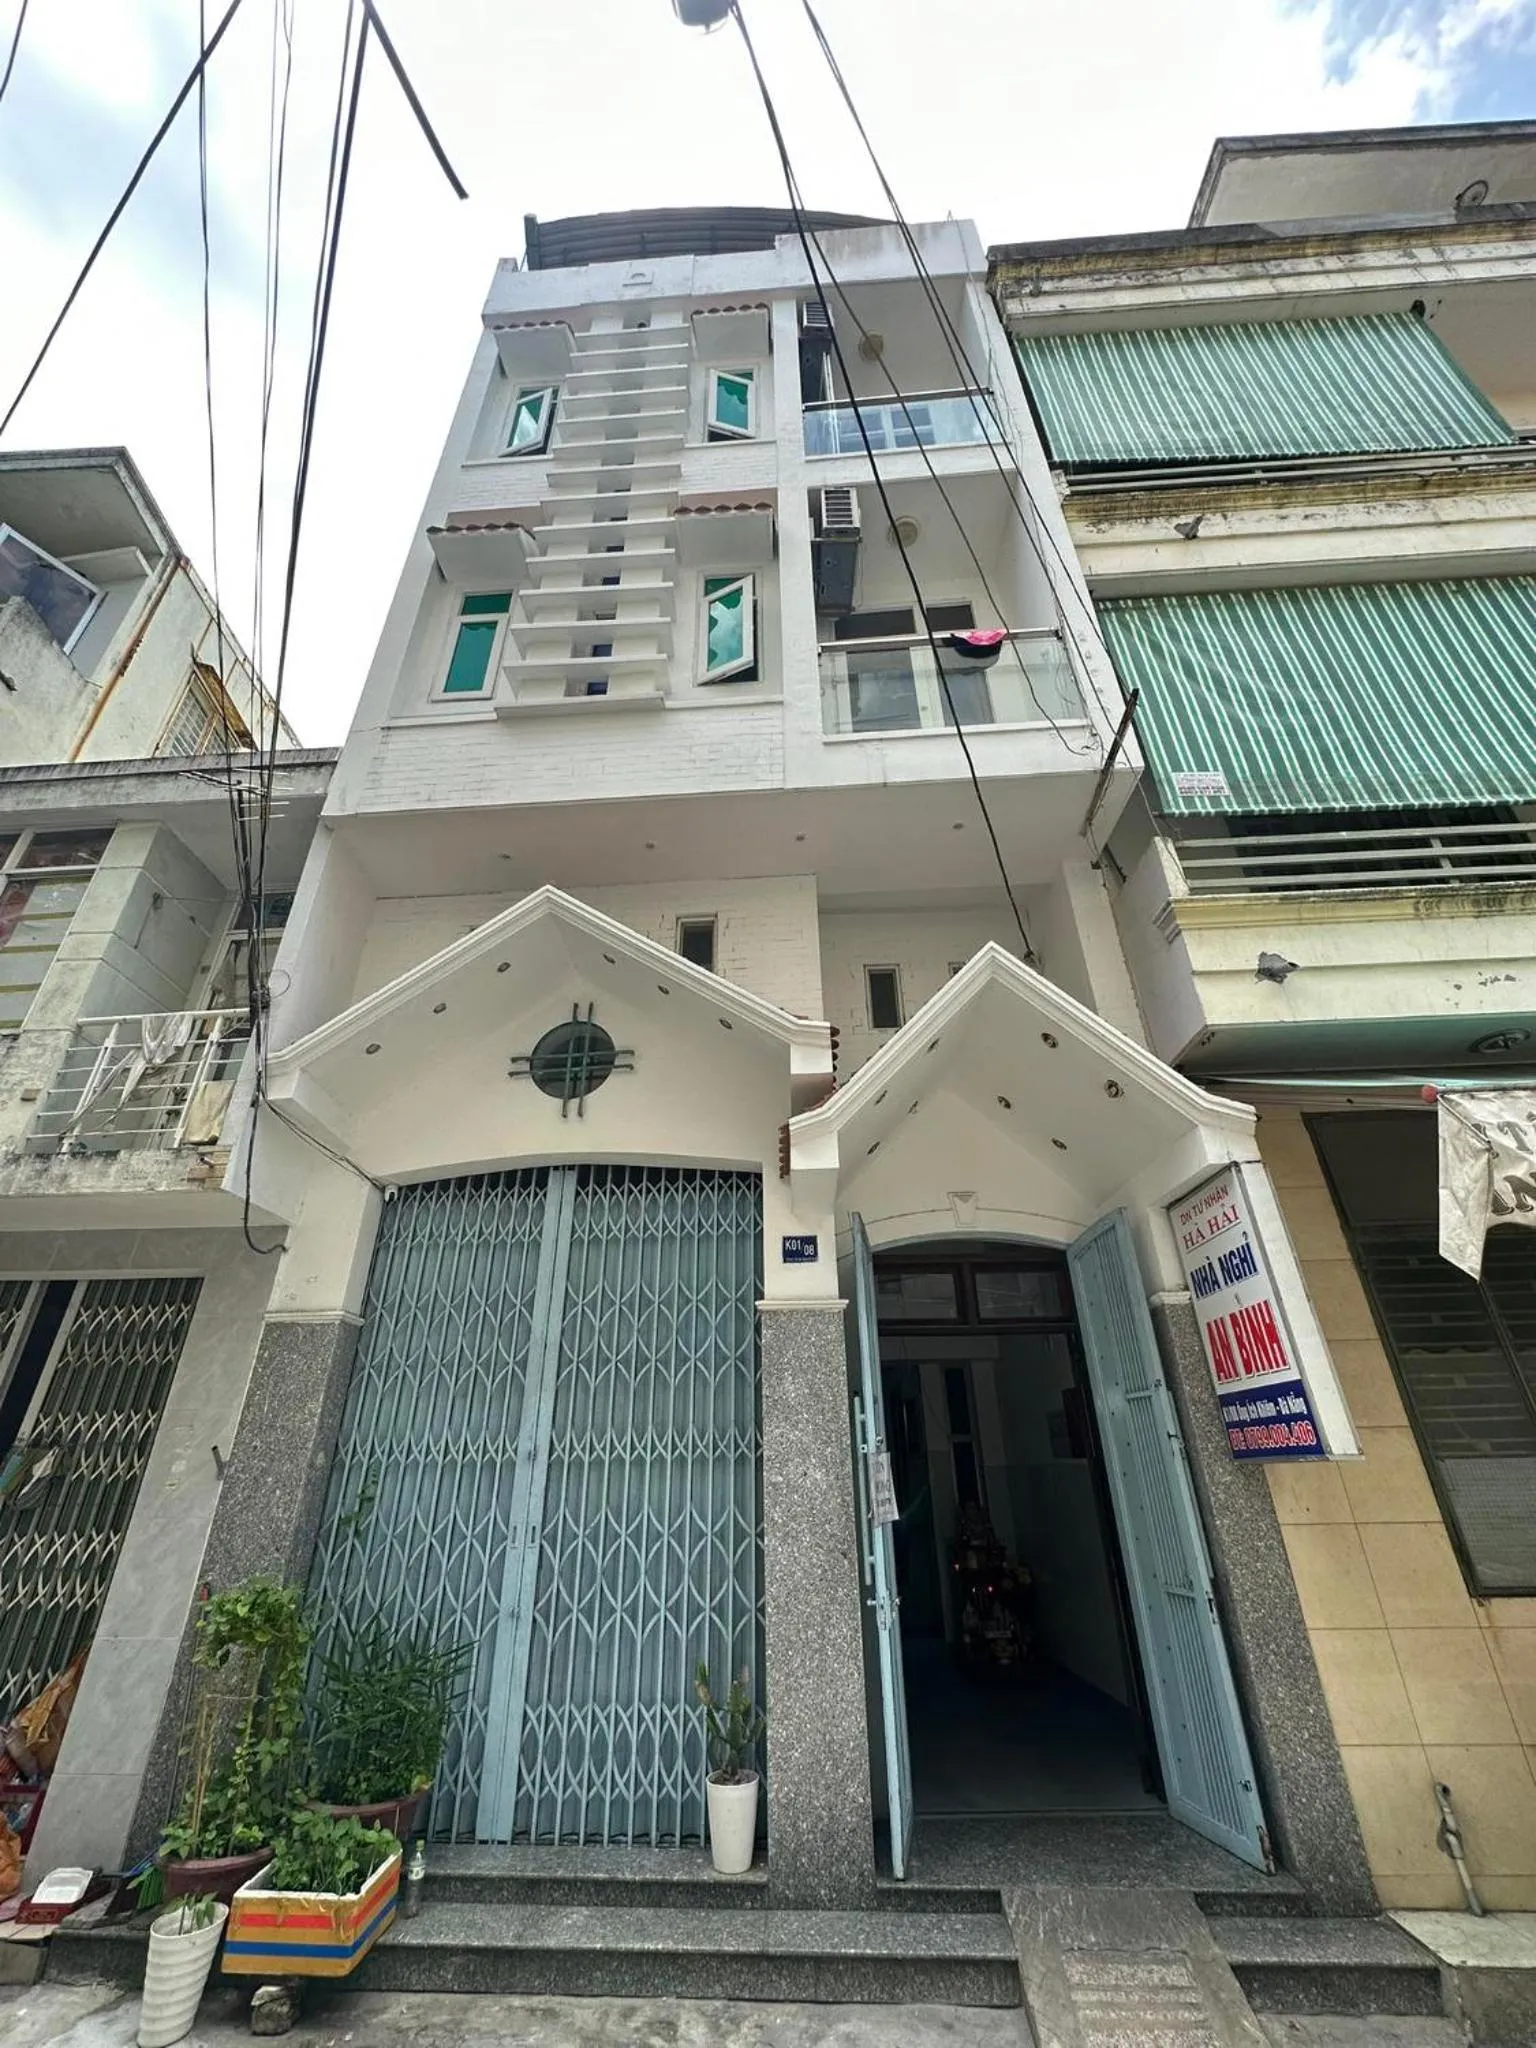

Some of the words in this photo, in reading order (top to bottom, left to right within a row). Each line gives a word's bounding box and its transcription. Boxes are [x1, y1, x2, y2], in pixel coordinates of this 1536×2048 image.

[1180, 1210, 1193, 1225] DN
[1203, 1184, 1229, 1209] NHÂN
[1183, 1222, 1206, 1250] HÀ
[1190, 1255, 1221, 1299] NHÀ
[1218, 1231, 1258, 1287] NGHỈ
[1206, 1315, 1241, 1384] AN
[1228, 1293, 1290, 1378] BÌNH
